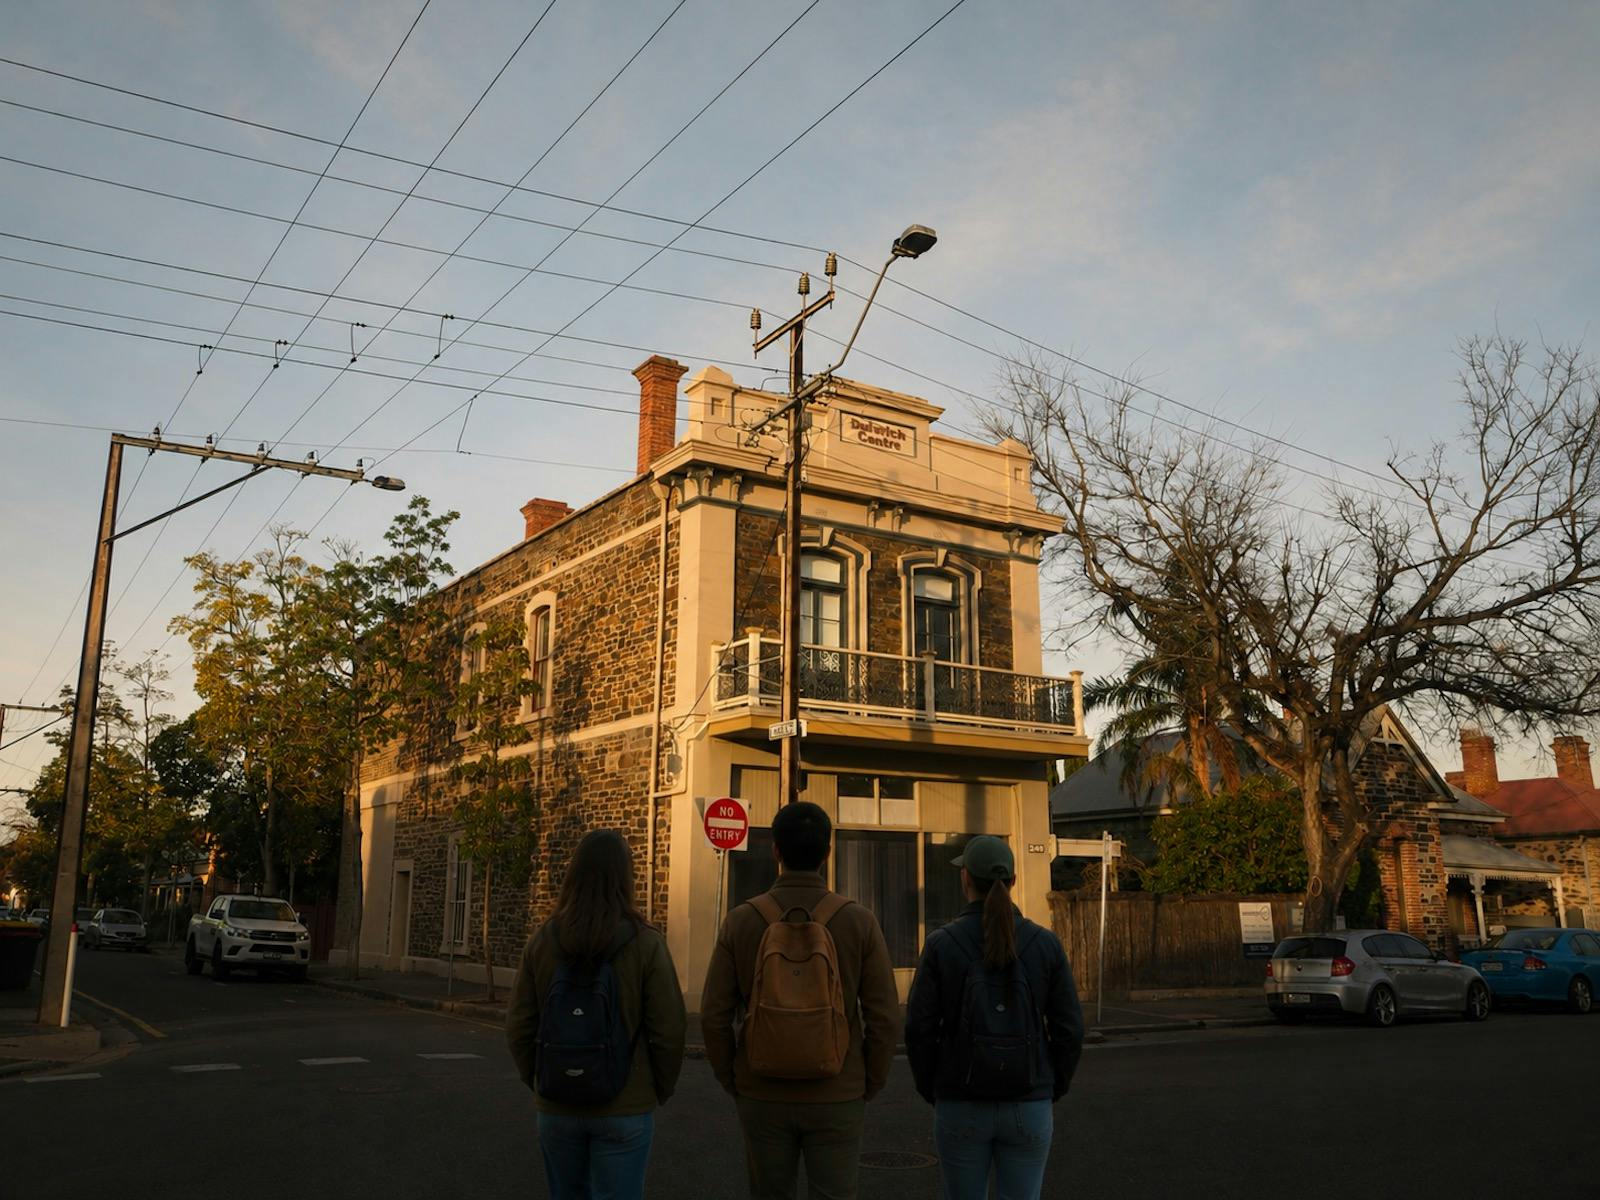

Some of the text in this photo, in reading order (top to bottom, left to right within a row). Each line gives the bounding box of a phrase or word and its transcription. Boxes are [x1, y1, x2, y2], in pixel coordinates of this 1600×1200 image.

[850, 418, 906, 441] Dulwich
[858, 431, 901, 450] Centre
[719, 806, 734, 817] NO
[710, 828, 741, 841] ENTRY
